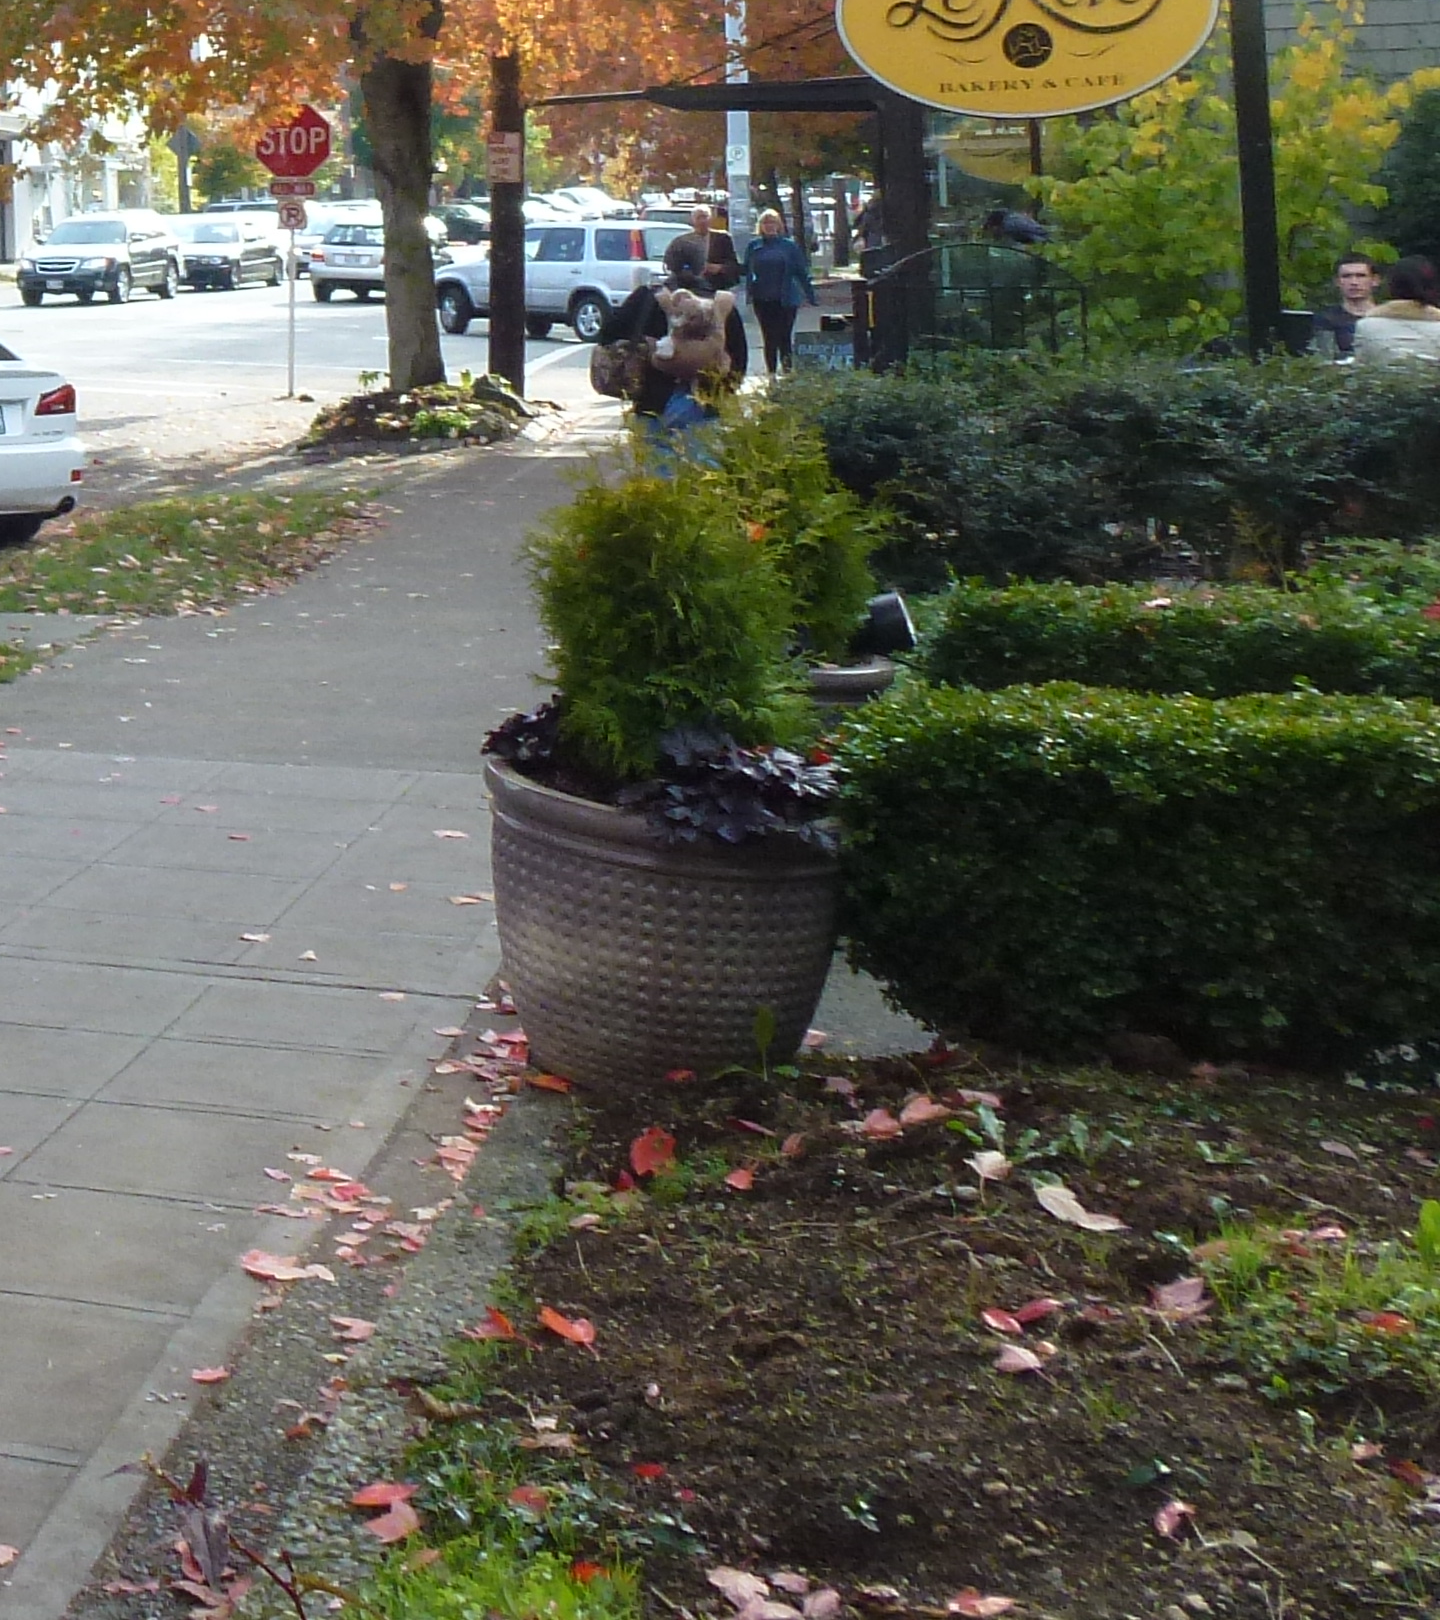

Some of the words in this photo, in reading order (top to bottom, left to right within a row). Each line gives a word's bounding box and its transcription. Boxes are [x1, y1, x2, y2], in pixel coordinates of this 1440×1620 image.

[939, 77, 1034, 93] BAKERY
[1041, 77, 1058, 90] &
[260, 126, 327, 155] STOP
